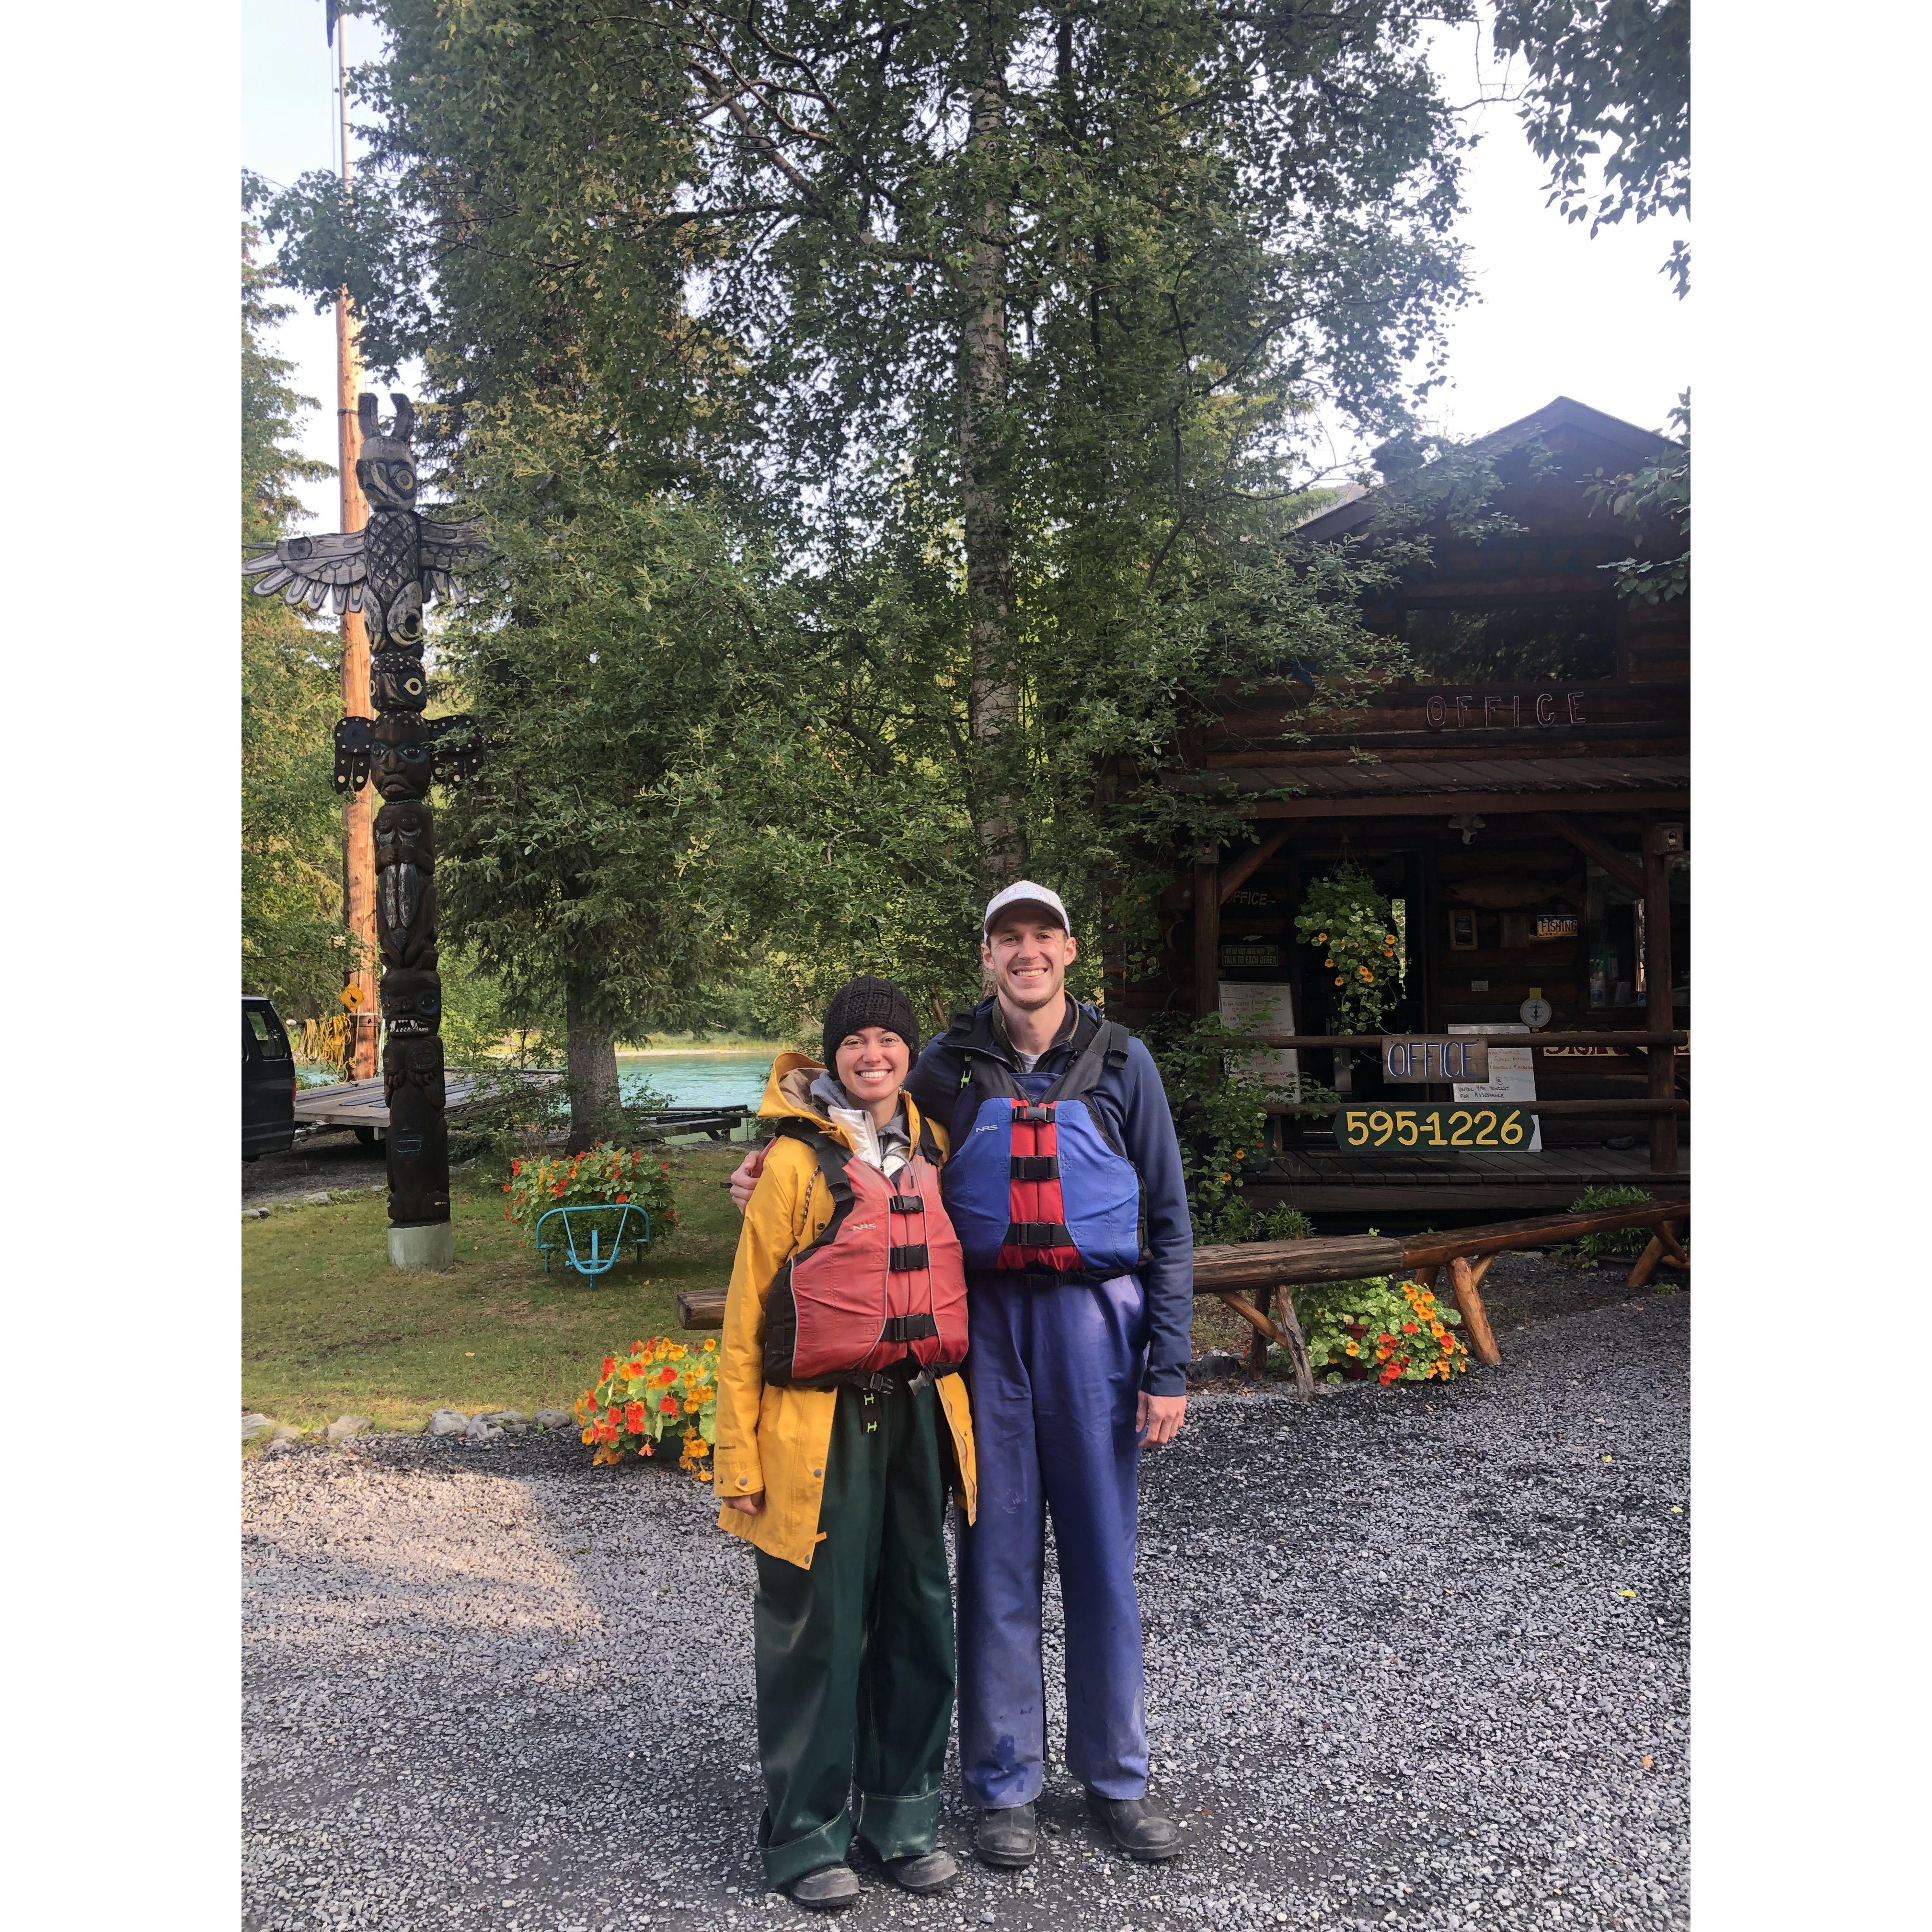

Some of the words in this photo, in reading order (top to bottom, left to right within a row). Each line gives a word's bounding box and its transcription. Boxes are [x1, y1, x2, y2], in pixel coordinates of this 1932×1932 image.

[1426, 691, 1586, 727] OFFICE
[1542, 921, 1577, 932] FISHING
[1224, 955, 1237, 964] TALK
[1238, 955, 1244, 964] TO
[1245, 955, 1259, 964] EACH
[1260, 955, 1276, 964] OTHER
[1387, 1042, 1478, 1078] OFFICE
[976, 1124, 998, 1133] NRS
[1346, 1109, 1524, 1148] 595-1226
[852, 1223, 876, 1231] NRS
